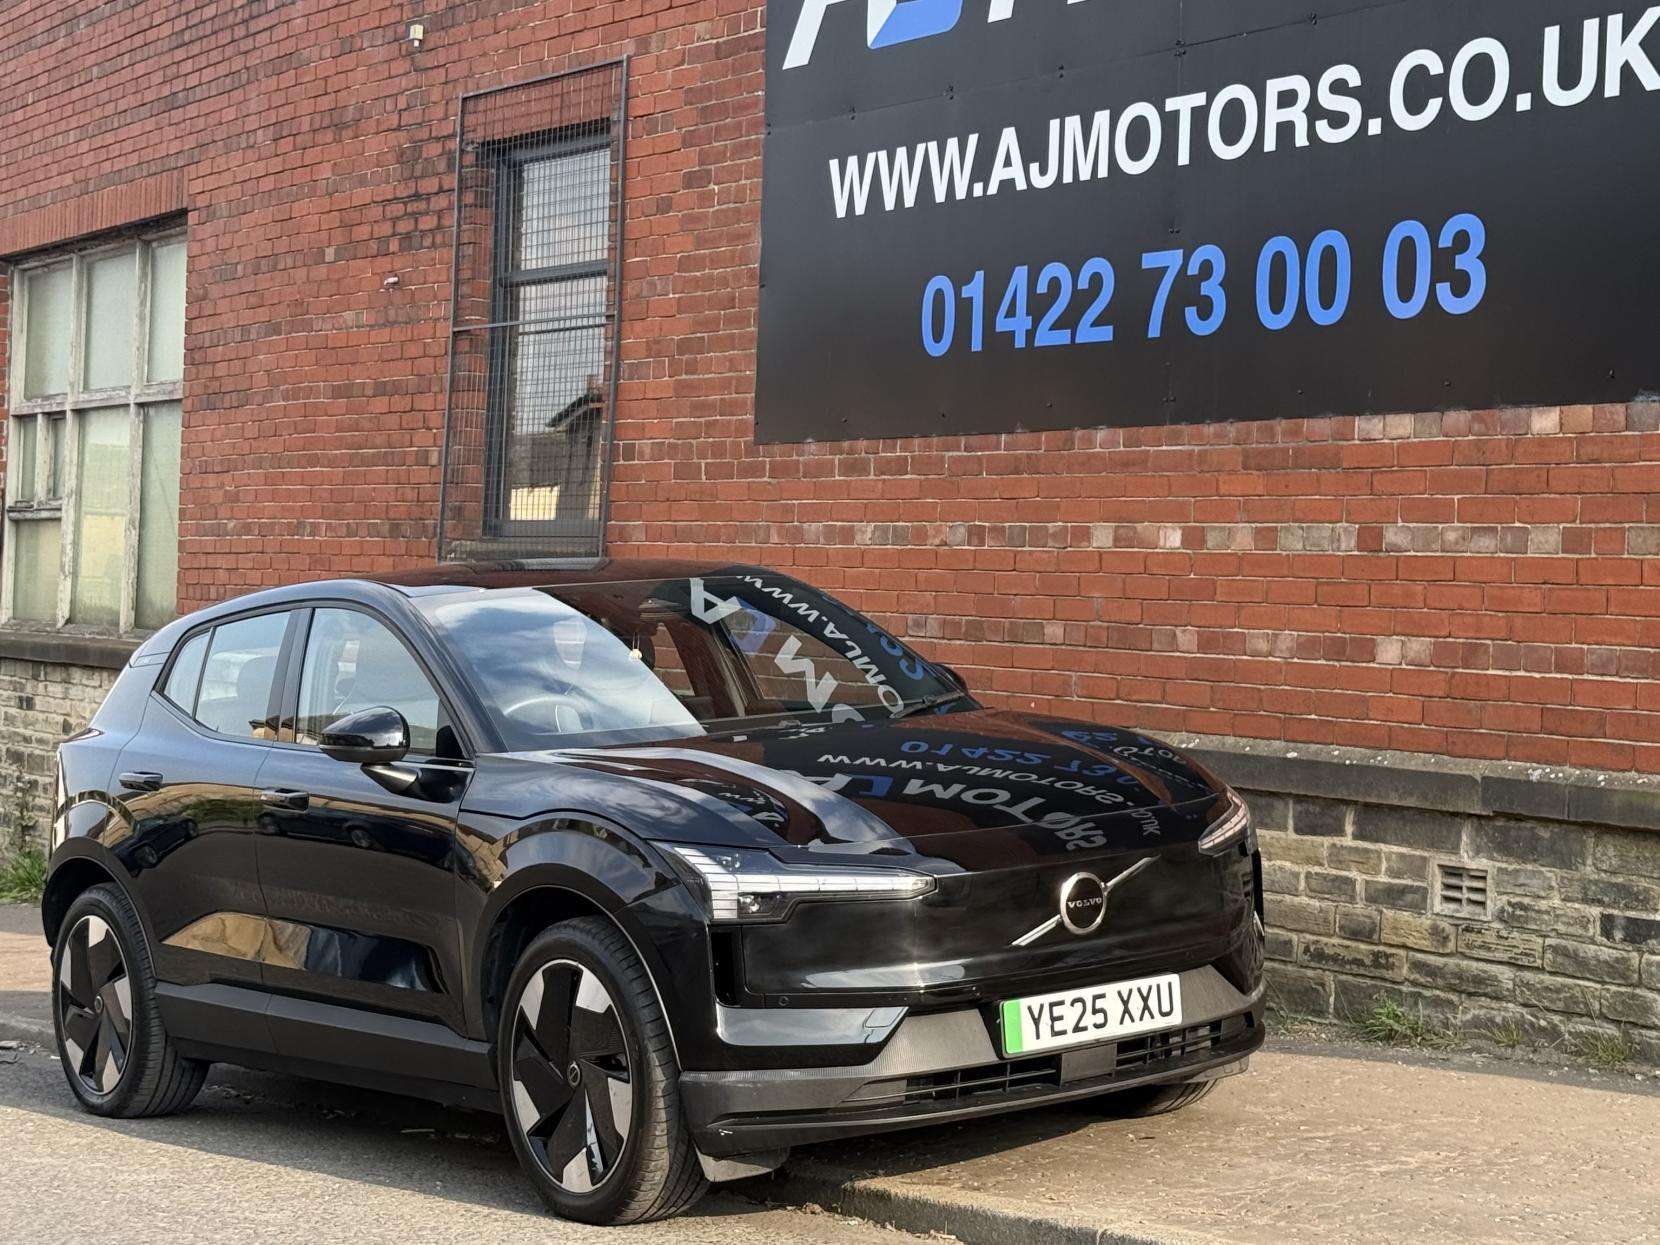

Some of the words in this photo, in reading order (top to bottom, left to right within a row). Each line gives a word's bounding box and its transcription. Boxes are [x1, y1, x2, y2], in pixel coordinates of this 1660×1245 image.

[829, 6, 1660, 218] WWW.AJMOTORS.CO.UK
[921, 257, 1114, 356] 01422
[1141, 244, 1226, 338] 73
[1255, 229, 1351, 330] 00
[1382, 213, 1486, 319] 03
[1067, 897, 1102, 908] VOLVO
[1028, 994, 1108, 1040] YE25
[1118, 982, 1174, 1025] XXU
